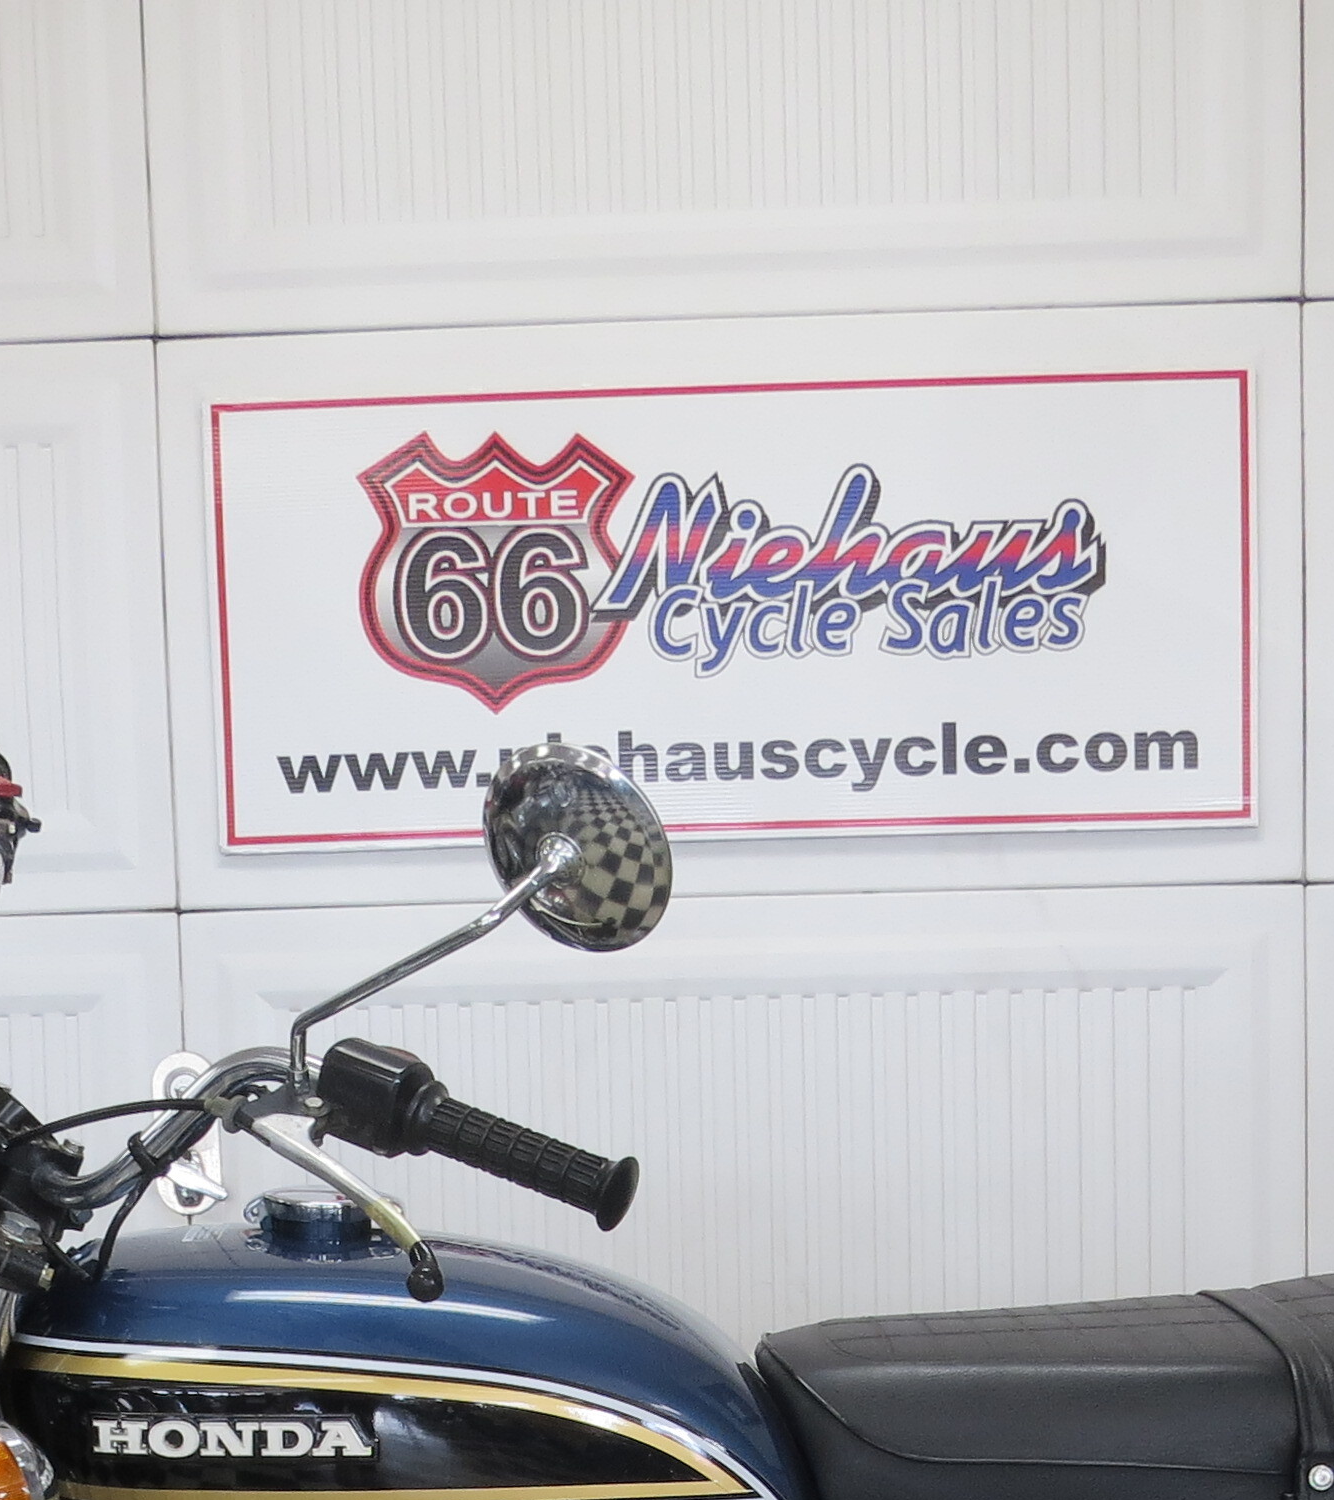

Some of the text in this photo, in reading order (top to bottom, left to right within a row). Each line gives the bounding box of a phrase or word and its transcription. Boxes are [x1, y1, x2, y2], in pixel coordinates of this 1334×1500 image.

[408, 489, 579, 521] ROUTE
[591, 463, 1104, 616] Niehaus
[395, 525, 588, 663] 66
[649, 577, 1087, 678] Cycle Sales
[276, 721, 1200, 794] www.hauscycle.com
[91, 1417, 374, 1459] HONDA
